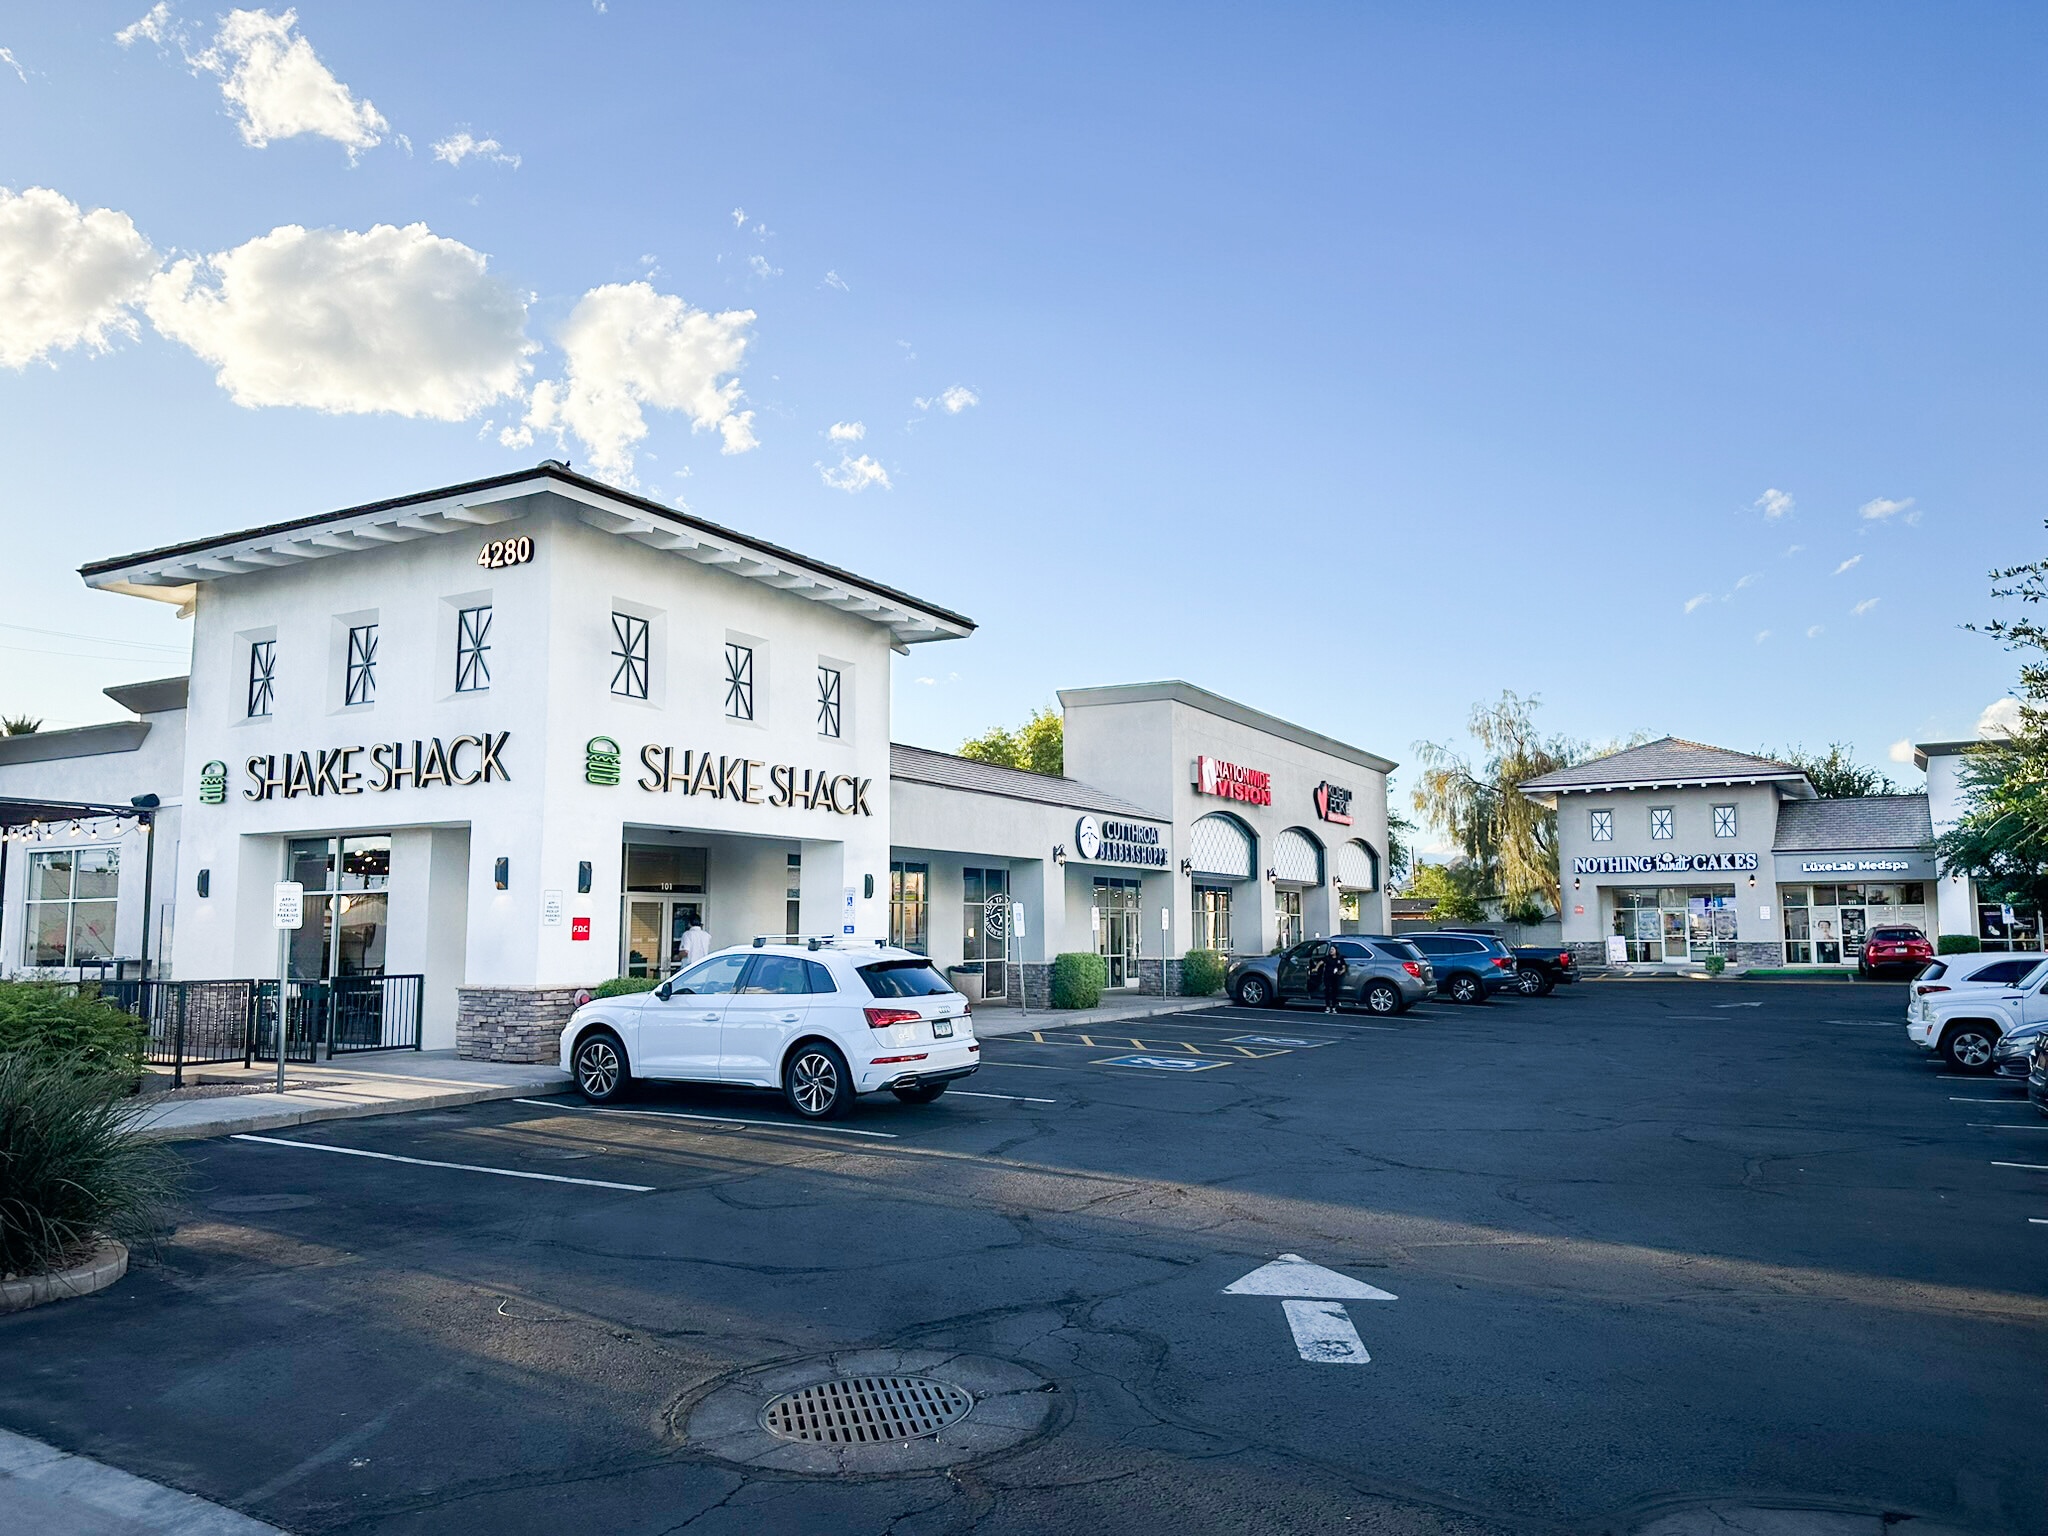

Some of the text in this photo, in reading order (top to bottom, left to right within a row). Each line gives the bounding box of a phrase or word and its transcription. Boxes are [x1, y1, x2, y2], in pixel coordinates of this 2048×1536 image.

[477, 536, 534, 569] 4280
[243, 731, 511, 801] SHAKE SHACK
[1215, 760, 1271, 789] NATIONWIDE
[638, 743, 873, 817] SHAKE SHACK
[1216, 779, 1272, 806] VISION
[1103, 821, 1160, 845] CUTTHROAT
[1097, 841, 1168, 866] BARBERSHOPPE
[1573, 856, 1652, 873] NOTHING
[1692, 853, 1758, 871] CAKES
[1802, 860, 1909, 873] LüxeLab Medspa
[661, 882, 673, 891] 101
